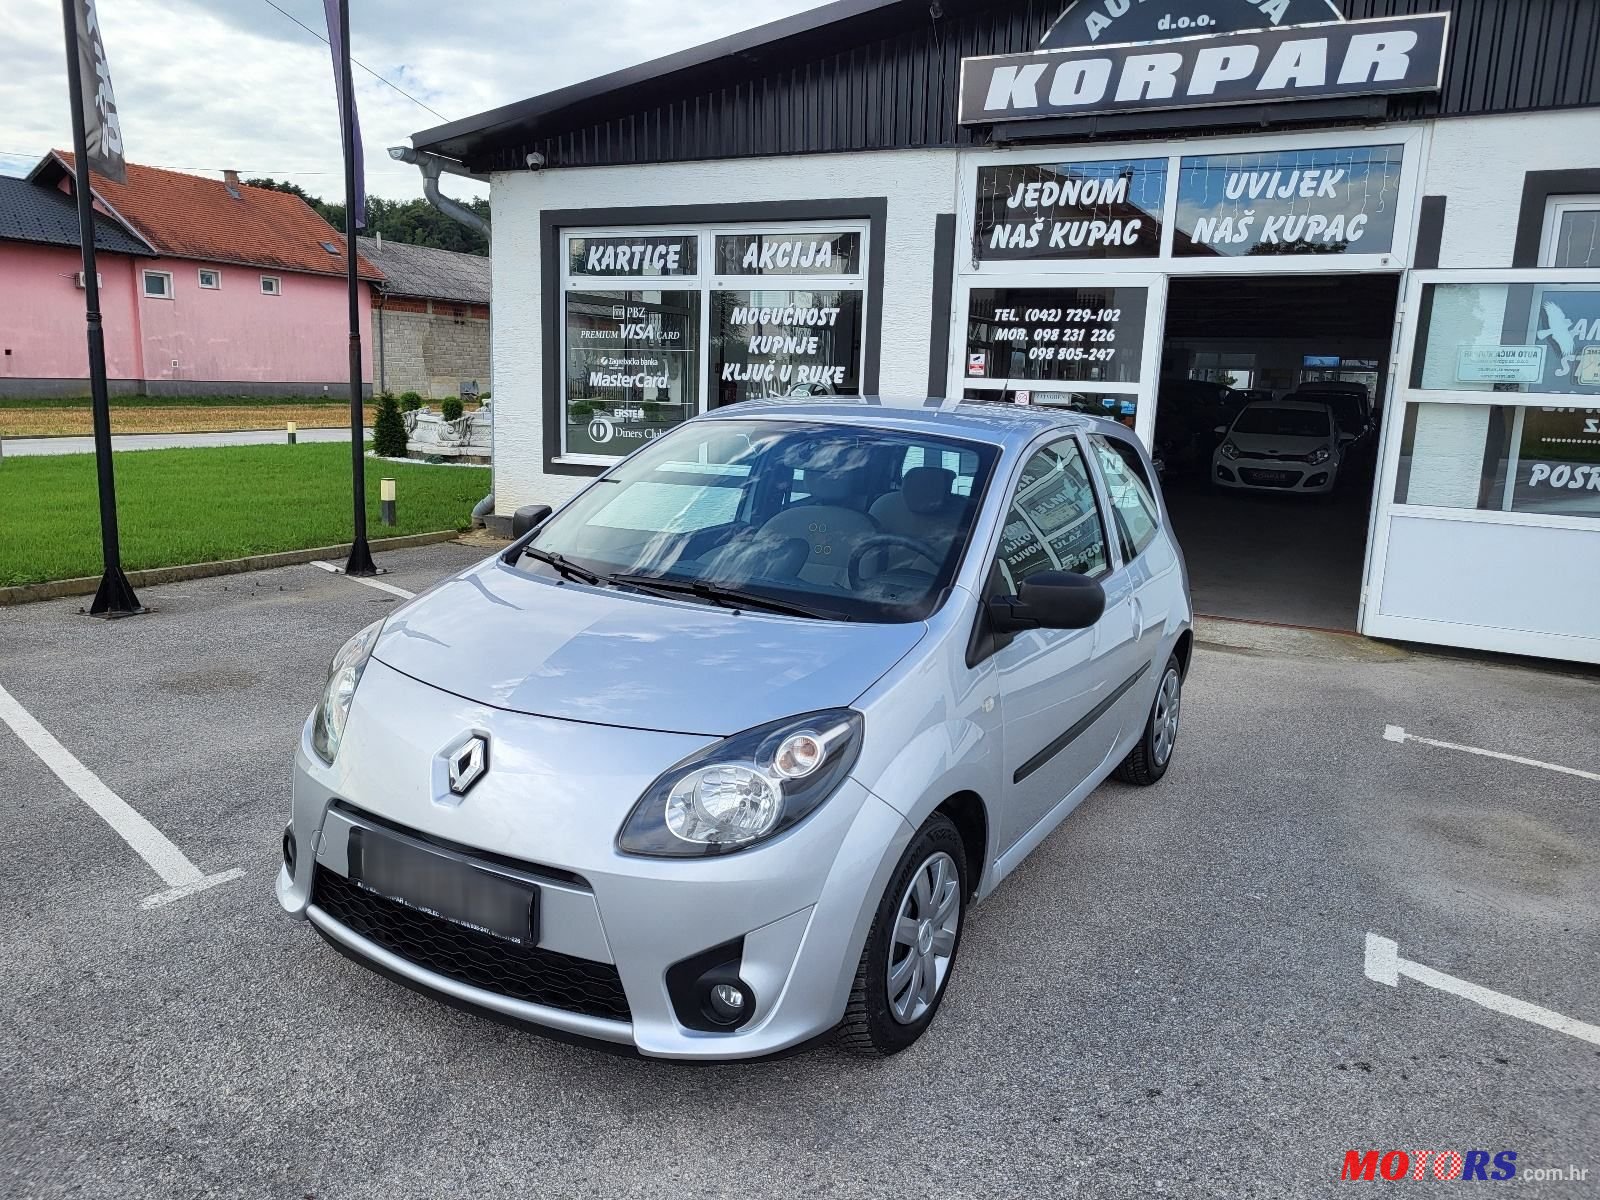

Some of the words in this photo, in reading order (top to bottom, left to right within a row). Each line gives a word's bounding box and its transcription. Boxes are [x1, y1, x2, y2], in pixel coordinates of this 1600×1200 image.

[1157, 14, 1216, 30] d.o.o.
[983, 30, 1417, 110] KORPAR
[1007, 178, 1129, 209] JEDNOM
[1225, 169, 1345, 200] UVIJEK
[990, 219, 1044, 249] NAŠ
[1049, 219, 1142, 247] KUPAC
[1191, 210, 1254, 244] NAŠ
[1257, 213, 1368, 242] KUPAC
[587, 244, 681, 271] KARTICE
[743, 242, 832, 269] AKCIJA
[627, 307, 645, 318] PBZ
[730, 302, 840, 326] MOGUĆNOST
[994, 309, 1020, 322] TEL.
[1025, 308, 1062, 322] (042)
[1066, 309, 1121, 322] 729-102
[580, 330, 619, 339] PREMIUM
[619, 323, 654, 340] VISA
[656, 331, 680, 340] CARD
[994, 328, 1029, 341] MOB.
[1033, 329, 1060, 341] 098
[1062, 329, 1085, 341] 231
[1090, 329, 1116, 342] 226
[748, 335, 819, 355] KUPNJE
[1028, 347, 1055, 360] 098
[1057, 348, 1116, 361] 805-247
[641, 357, 659, 366] banka
[589, 372, 669, 388] MasterCard
[721, 360, 776, 382] KLJUČ
[778, 364, 794, 382] U
[797, 364, 845, 385] RUKE
[614, 408, 638, 418] ERSTE
[614, 427, 643, 438] Diners
